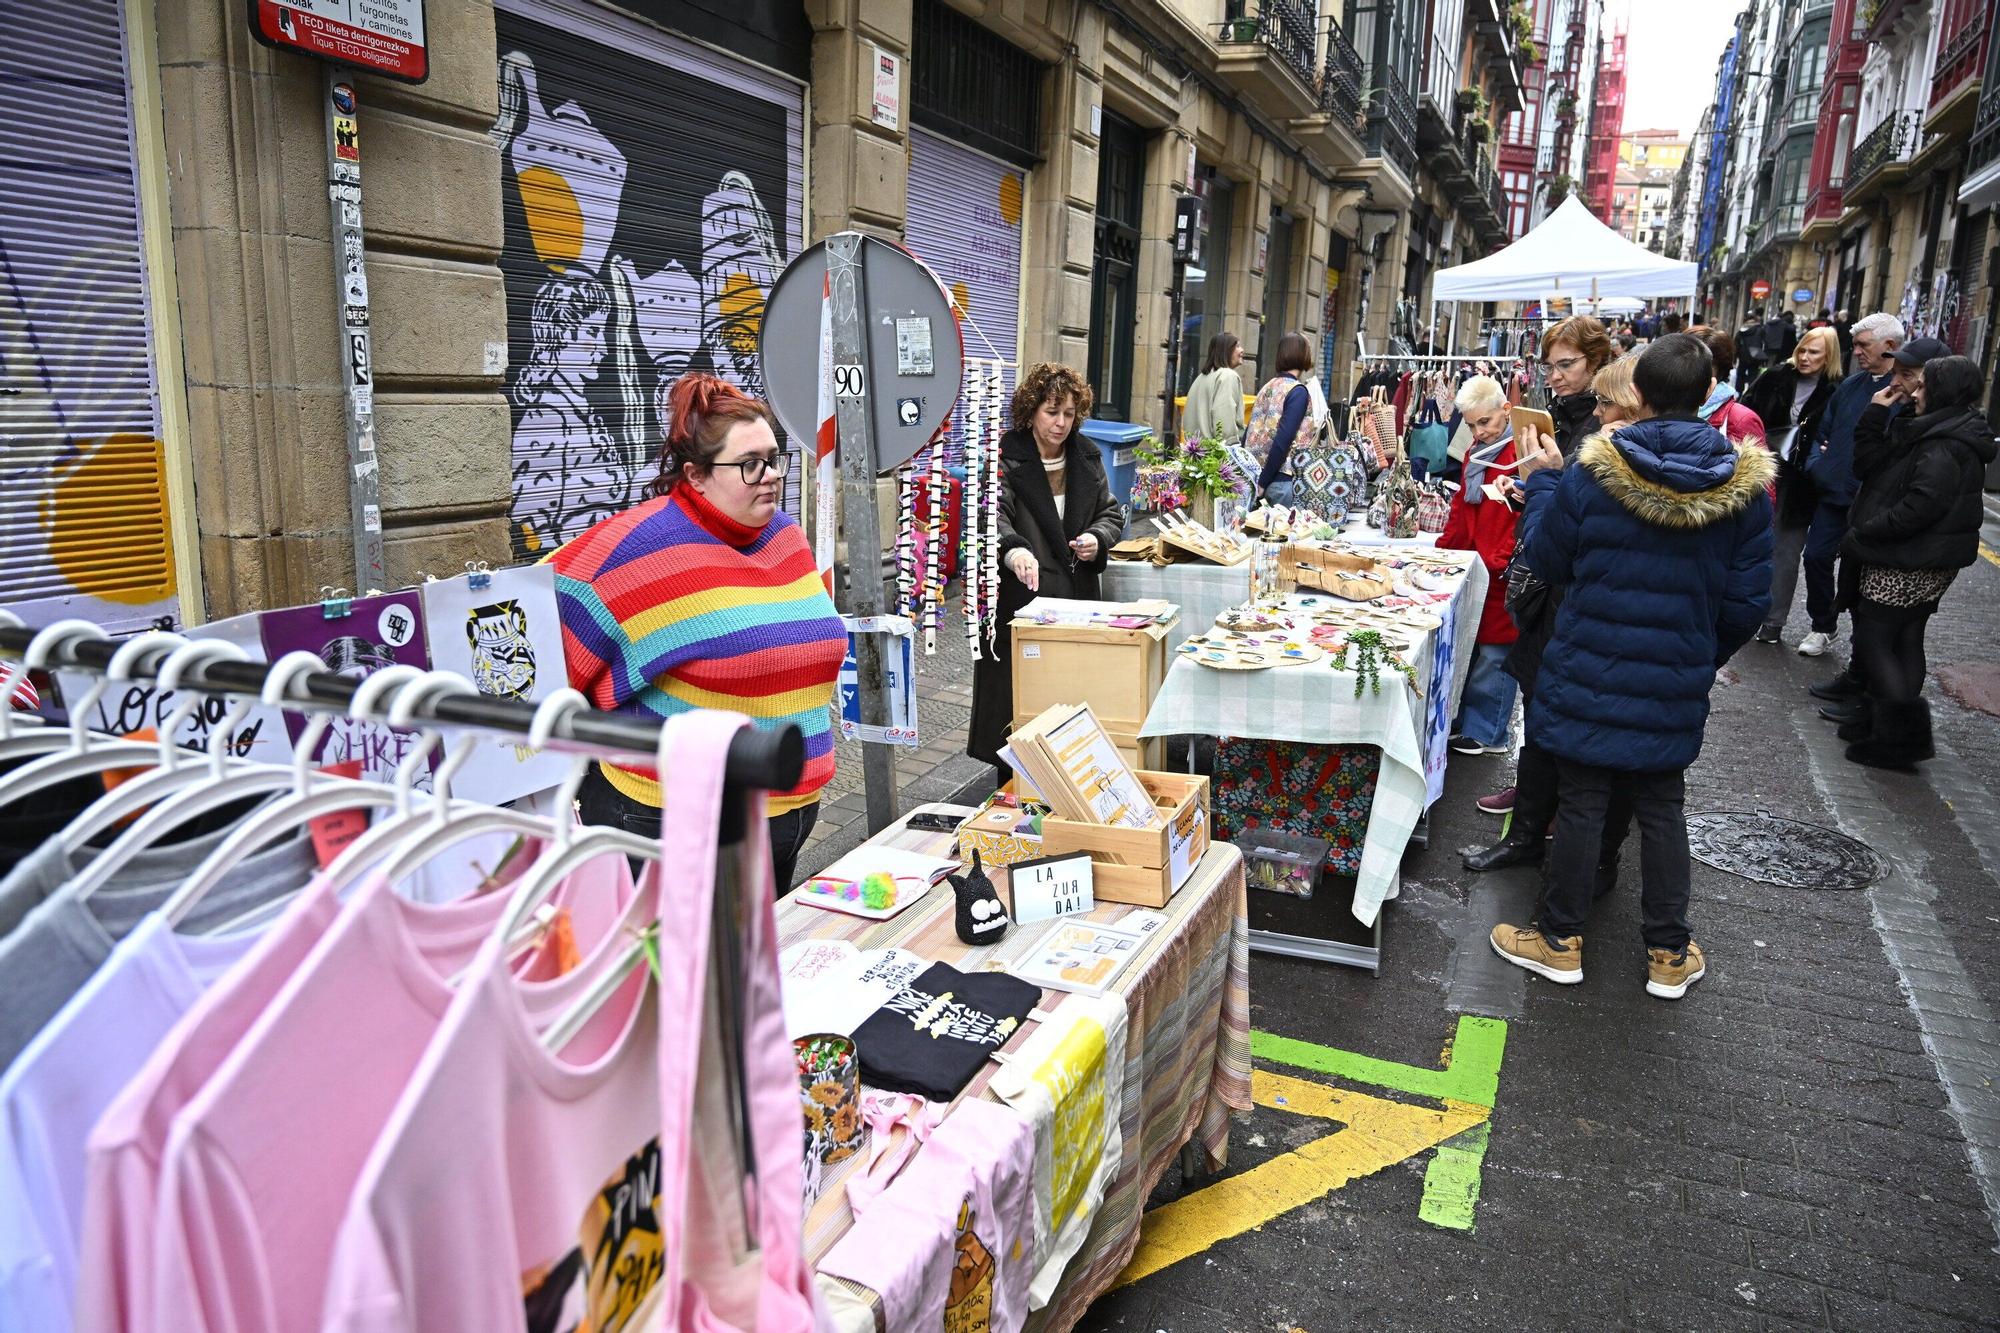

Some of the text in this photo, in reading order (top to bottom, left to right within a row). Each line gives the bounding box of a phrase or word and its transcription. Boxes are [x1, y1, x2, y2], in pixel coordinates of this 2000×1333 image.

[360, 1, 408, 26] furgonetas
[299, 14, 410, 55] TECD tiketa derrigorrezkoa
[360, 17, 413, 40] y camiones
[312, 35, 401, 68] Tique TECD obligatorio
[835, 366, 863, 395] 90
[1036, 866, 1053, 883] LA
[1055, 896, 1080, 915] DA!
